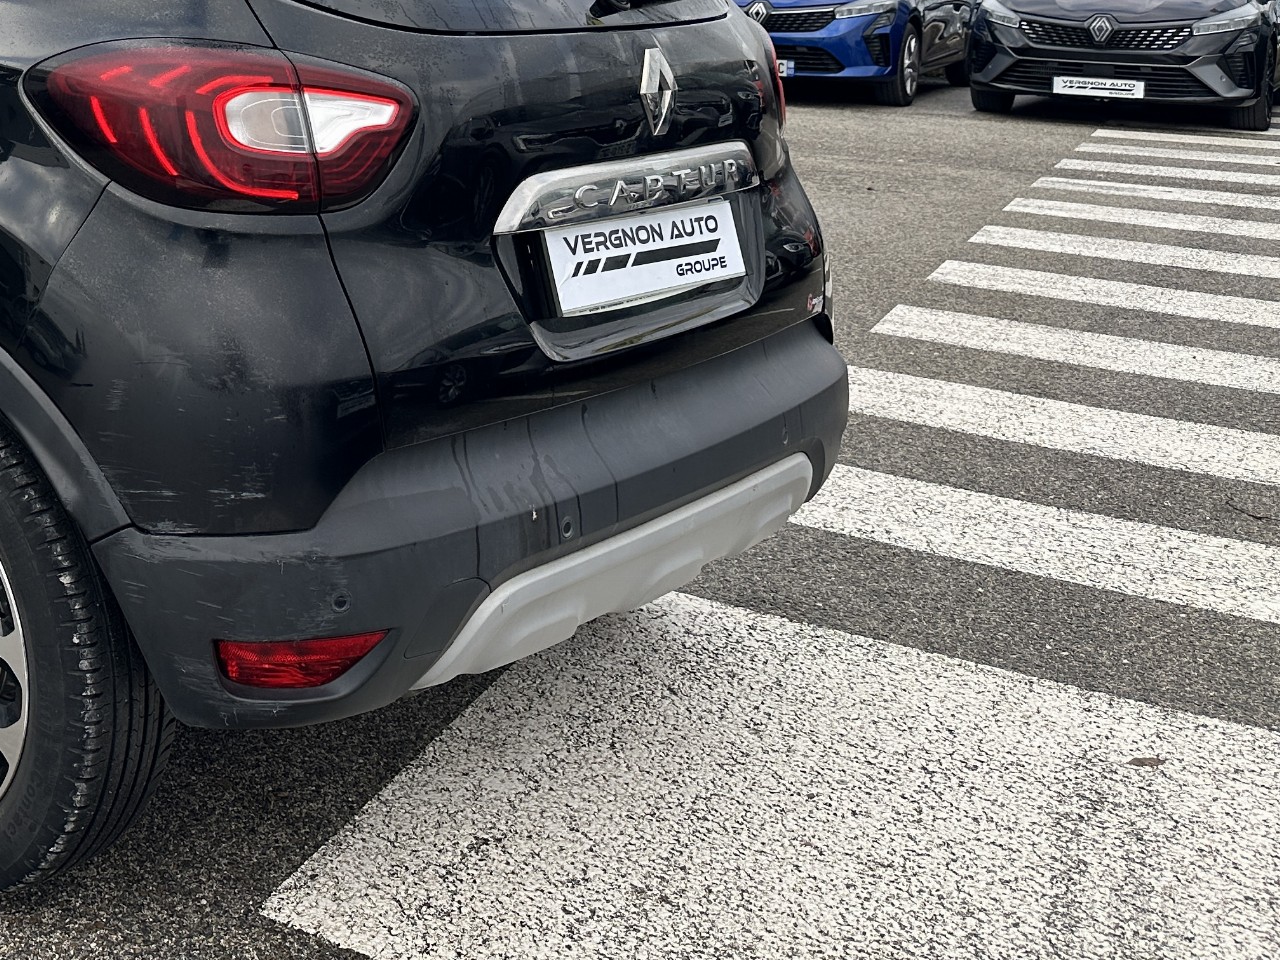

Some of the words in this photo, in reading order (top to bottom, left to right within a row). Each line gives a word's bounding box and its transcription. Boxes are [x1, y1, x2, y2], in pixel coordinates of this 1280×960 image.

[1061, 79, 1107, 87] VERGNON
[573, 159, 739, 209] CAPTUR
[563, 222, 664, 256] VERGNON
[670, 215, 719, 240] AUTO
[676, 255, 728, 277] GROUPE
